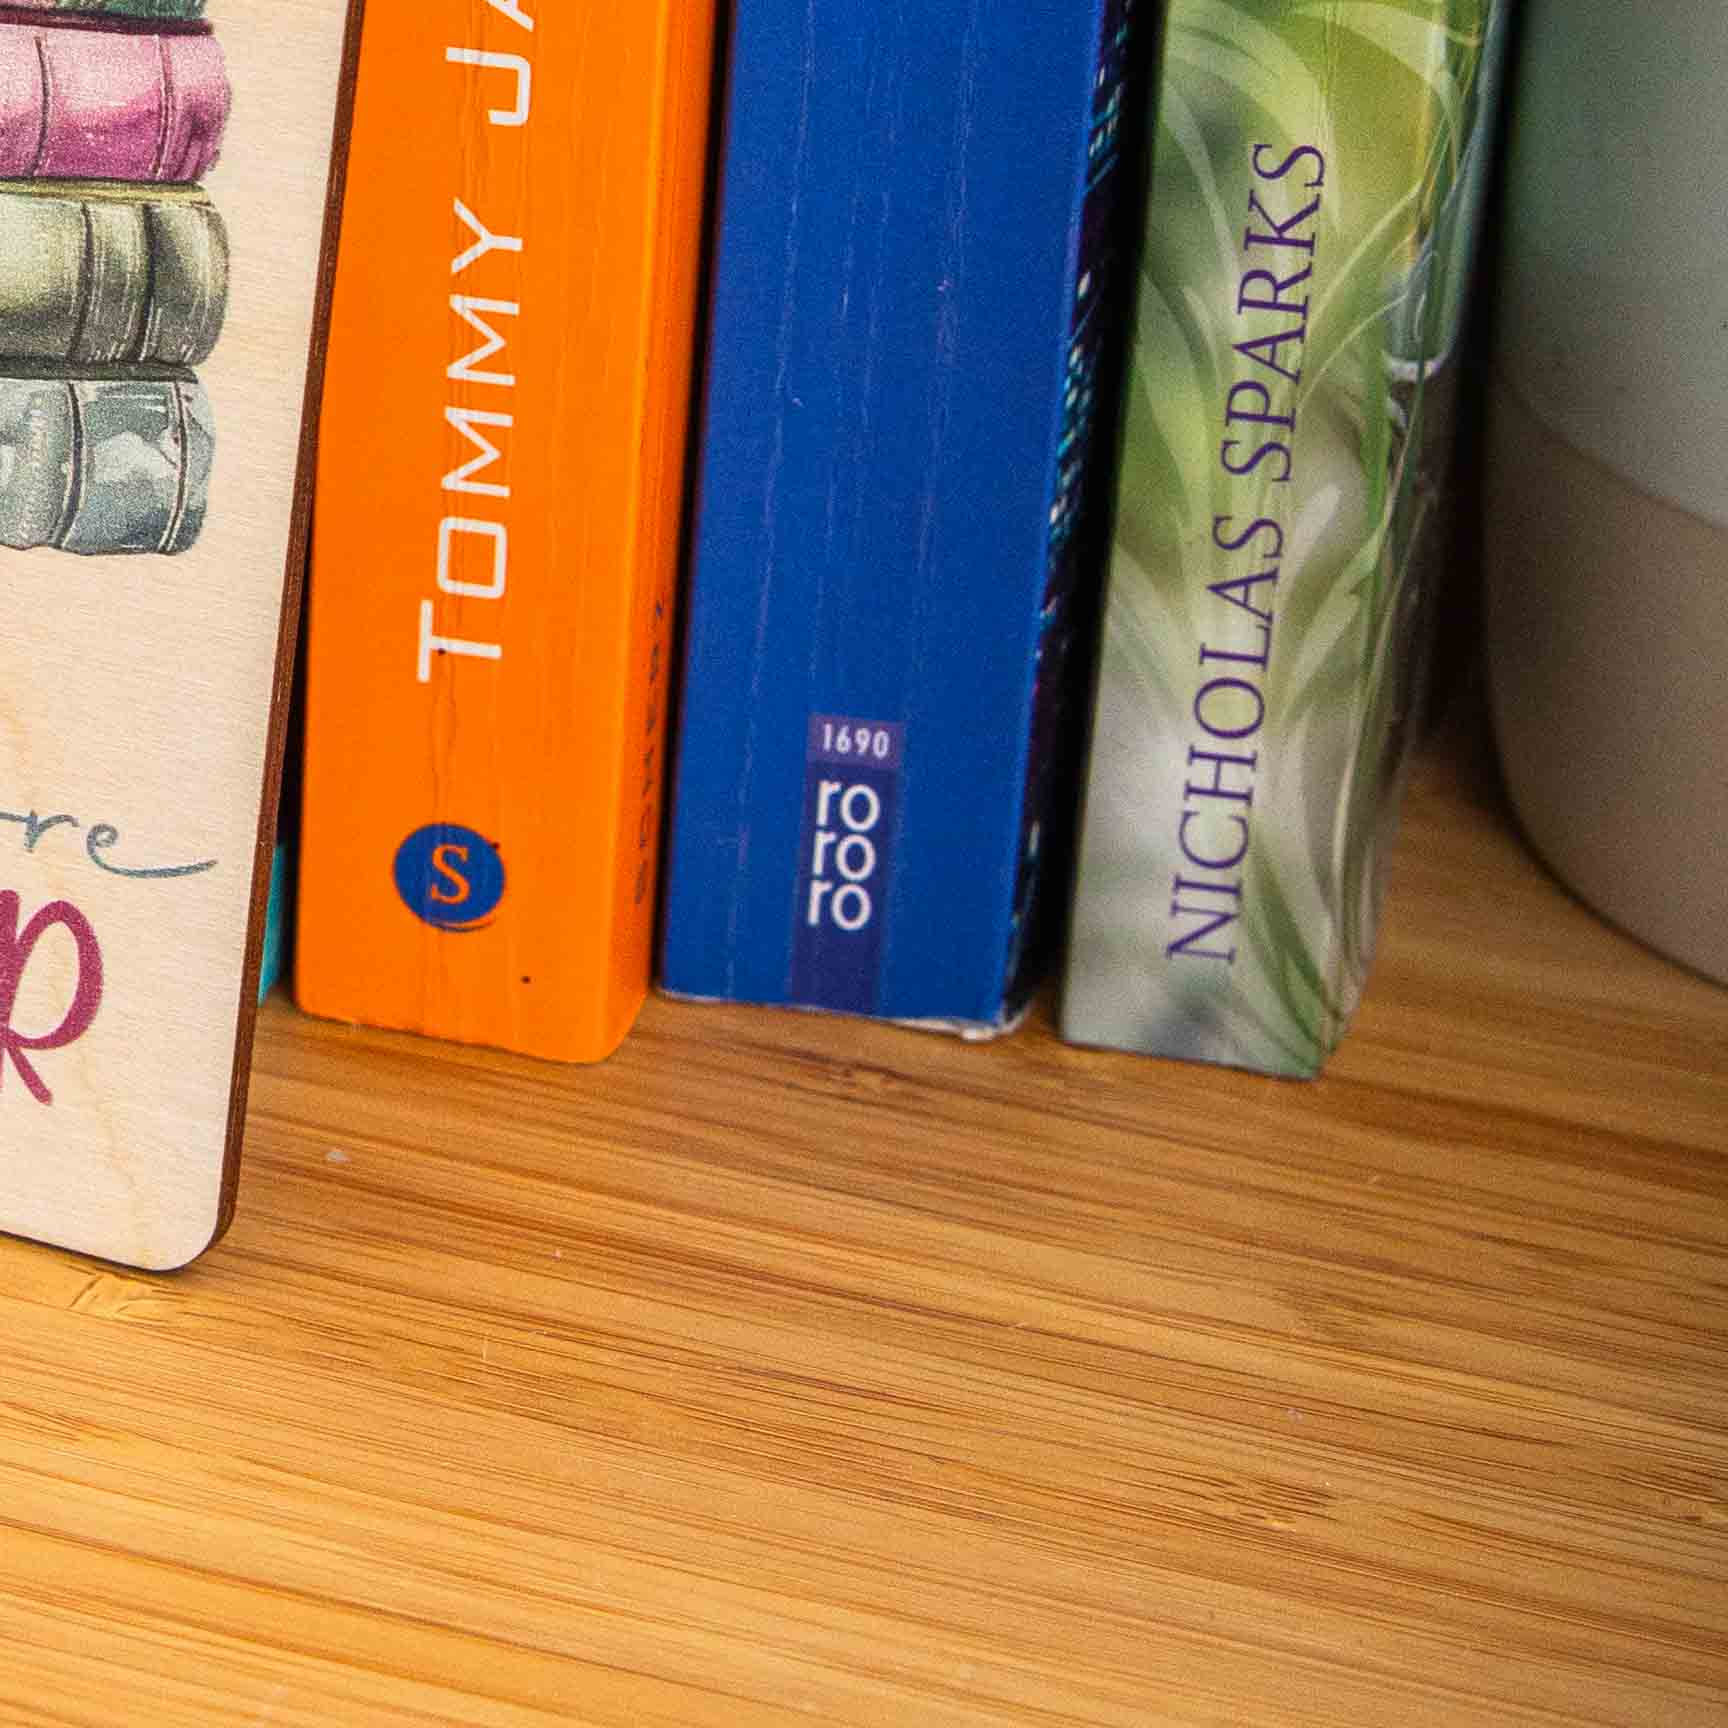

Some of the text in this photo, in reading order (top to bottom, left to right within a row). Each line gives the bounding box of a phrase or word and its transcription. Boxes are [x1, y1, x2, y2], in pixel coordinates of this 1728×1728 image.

[417, 198, 524, 683] TOMMY
[1164, 141, 1325, 965] NICHOLAS SPARKS
[822, 723, 890, 759] 1690
[817, 780, 881, 832] ro
[430, 844, 470, 904] S
[813, 831, 876, 882] ro
[808, 879, 872, 932] ro
